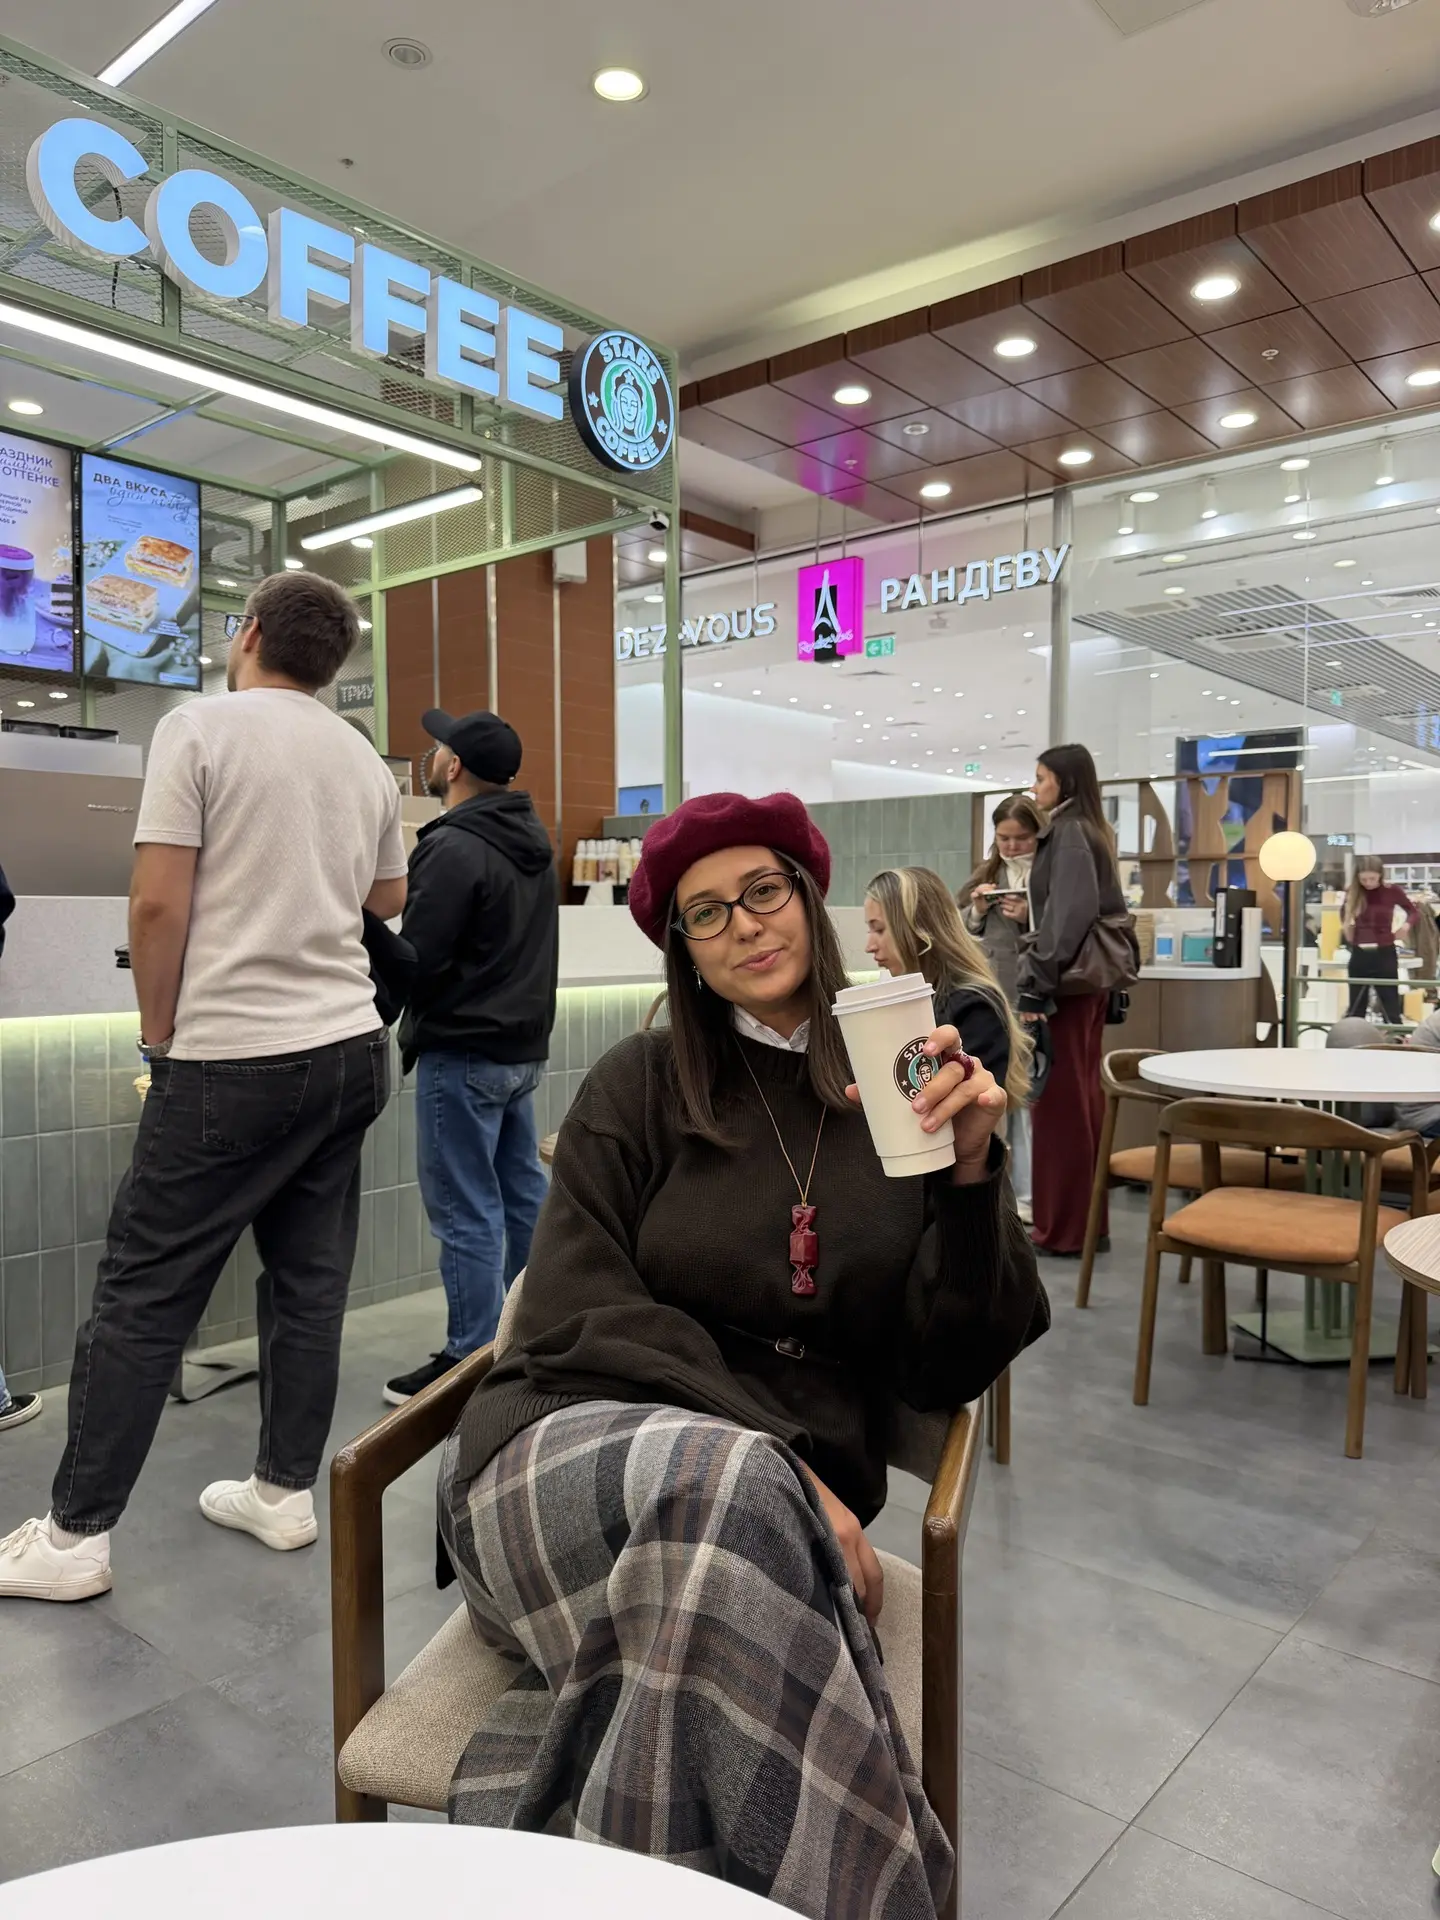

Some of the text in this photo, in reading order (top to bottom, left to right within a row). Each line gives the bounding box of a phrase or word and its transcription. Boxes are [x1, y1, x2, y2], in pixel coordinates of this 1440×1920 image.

[28, 117, 564, 421] COFFEE
[600, 336, 661, 385] STARS
[596, 416, 660, 463] COFFEE
[2, 466, 60, 488] ОТТЕНКЕ
[93, 472, 168, 499] ДВА ВКУСА
[880, 543, 1071, 614] РАНДЕВУ
[903, 1042, 925, 1061] STA
